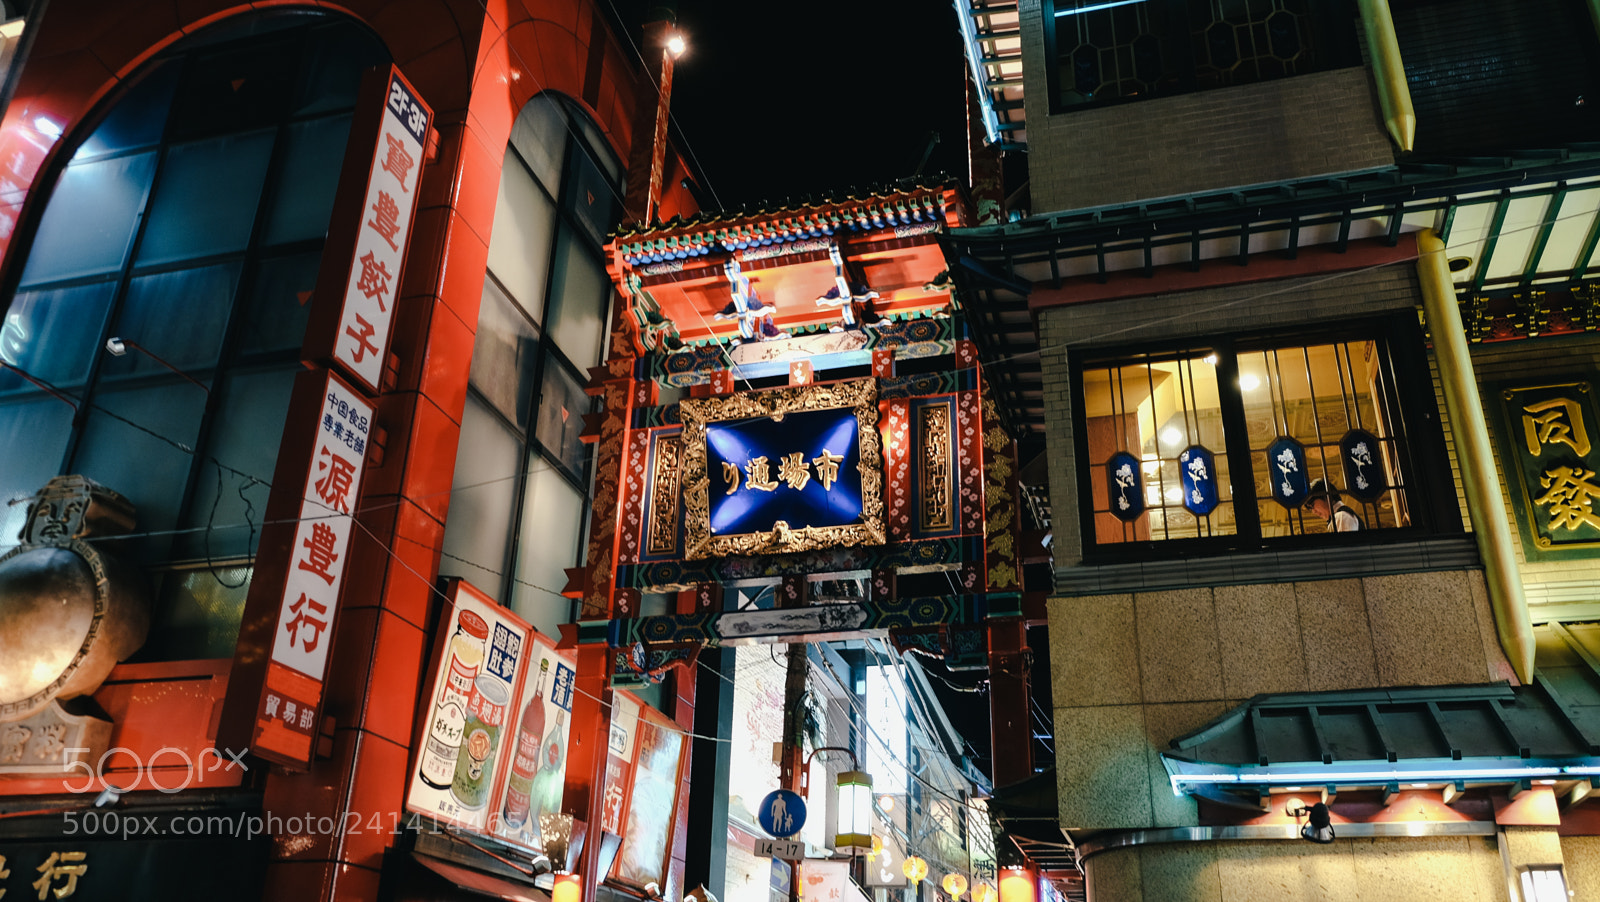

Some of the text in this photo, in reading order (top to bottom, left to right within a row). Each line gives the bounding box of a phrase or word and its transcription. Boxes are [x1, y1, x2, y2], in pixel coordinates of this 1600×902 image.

[721, 449, 844, 494] 市場通り
[265, 694, 315, 731] 貿易部
